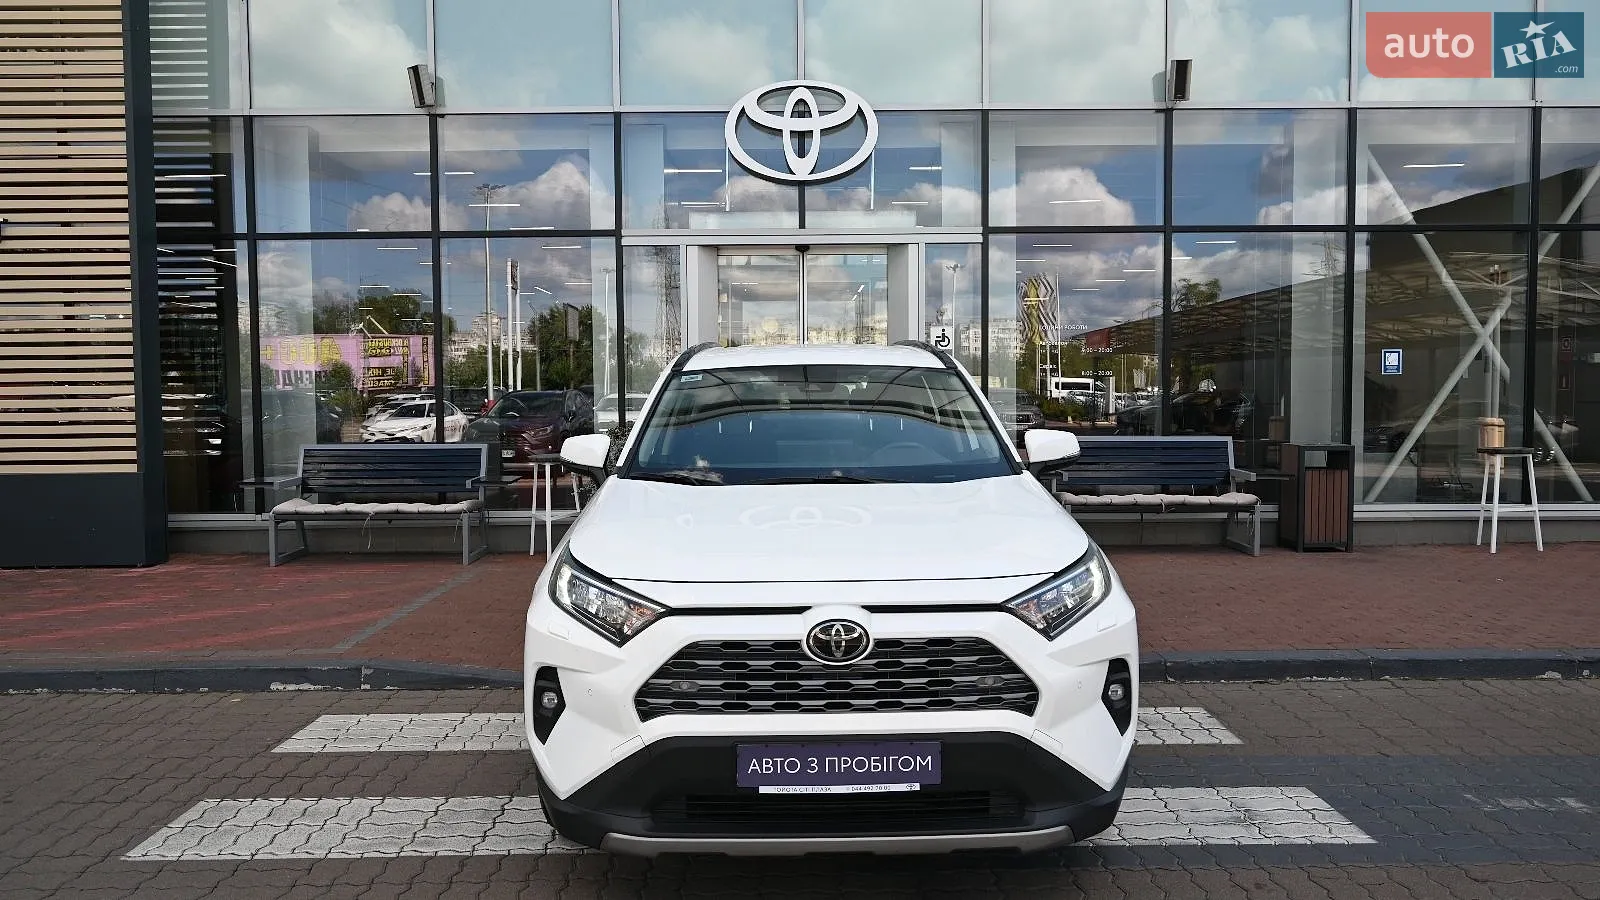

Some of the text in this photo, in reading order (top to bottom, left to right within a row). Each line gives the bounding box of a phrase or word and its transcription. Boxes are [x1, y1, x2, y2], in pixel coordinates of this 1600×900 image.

[748, 755, 933, 774] АВТО З ПРОБІГОМ
